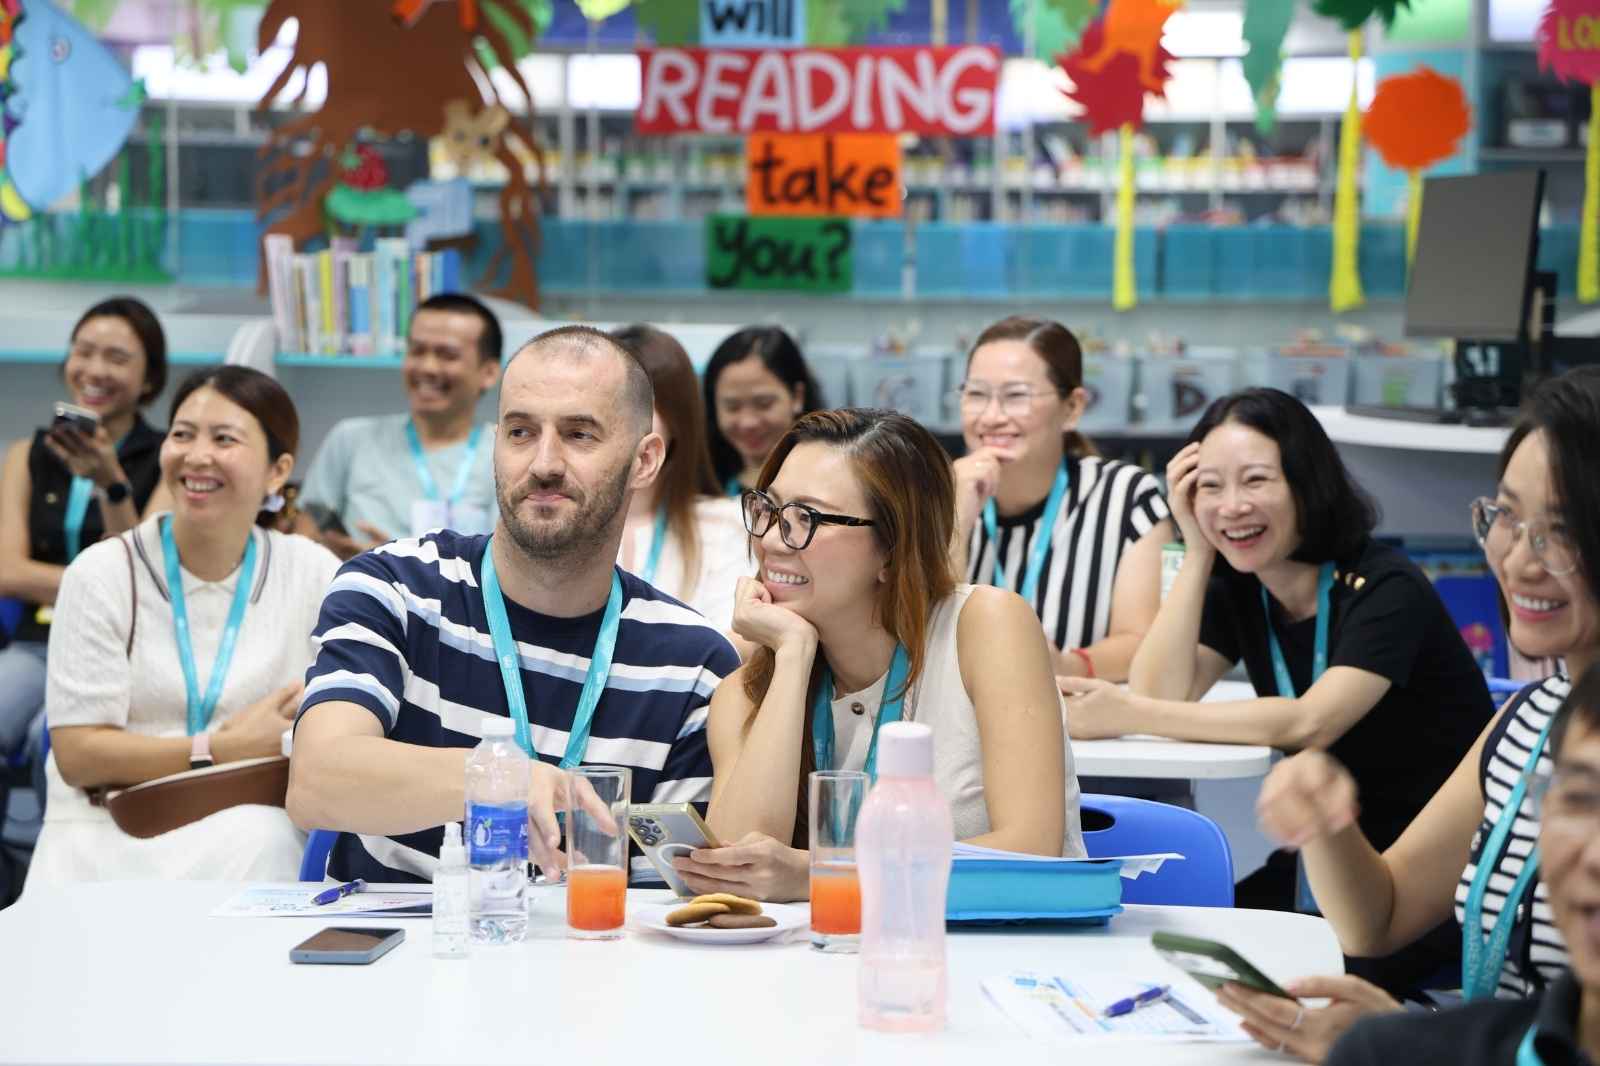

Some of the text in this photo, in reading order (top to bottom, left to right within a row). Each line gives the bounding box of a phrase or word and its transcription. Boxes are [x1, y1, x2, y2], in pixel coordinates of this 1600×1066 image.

[706, 0, 794, 39] will
[640, 46, 997, 133] READING
[752, 136, 895, 209] take
[707, 219, 852, 289] you?
